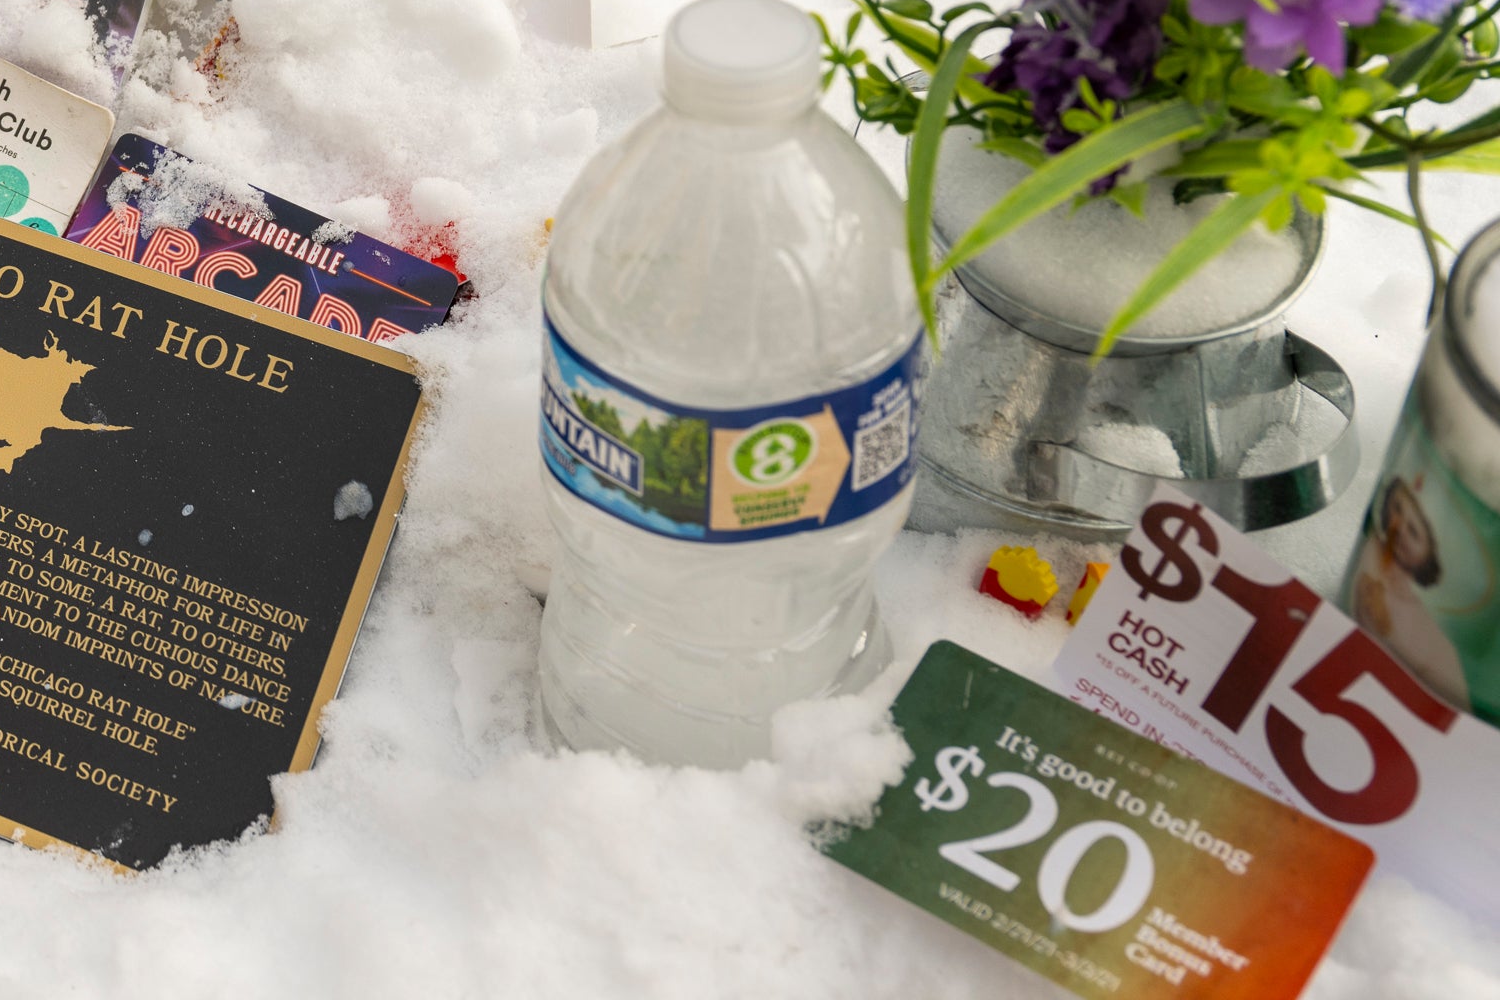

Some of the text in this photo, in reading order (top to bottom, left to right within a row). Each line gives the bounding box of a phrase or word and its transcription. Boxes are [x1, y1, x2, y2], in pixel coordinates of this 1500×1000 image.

[38, 279, 144, 339] RAT
[155, 319, 294, 394] HOLE
[14, 513, 69, 547] SPOT,
[71, 535, 86, 553] A
[90, 540, 178, 585] LASTING
[181, 573, 308, 633] IMPRESSION
[40, 548, 54, 566] A
[58, 553, 170, 608] METAPHOR
[172, 595, 214, 624] FOR
[217, 612, 265, 642] LIFE
[267, 630, 292, 652] IN
[7, 557, 34, 581] TO
[37, 570, 95, 607] SOME,
[99, 595, 115, 613] A
[119, 600, 164, 632] RAT,
[170, 618, 198, 642] TO
[201, 631, 287, 678] OTHERS,
[1118, 610, 1185, 660] HOT
[53, 599, 81, 623] TO
[86, 611, 128, 641] THE
[130, 630, 219, 675] CURIOUS
[221, 663, 292, 703] DANCE
[64, 629, 165, 680] IMPRINTS
[168, 669, 197, 691] OF
[1107, 632, 1190, 695] CASH
[1120, 501, 1462, 827] $15
[86, 688, 131, 717] RAT
[1075, 676, 1141, 727] SPEND
[1114, 665, 1141, 686] OFF
[1151, 691, 1201, 731] FUTURE
[101, 719, 158, 755] HOLE.
[75, 761, 178, 813] SOCIETY
[995, 725, 1040, 763] It's
[1038, 753, 1117, 801] good
[1115, 788, 1148, 818] to
[1149, 802, 1255, 877] belong
[914, 745, 1155, 934] $20
[939, 881, 994, 923] VALID
[1124, 942, 1189, 987] Card
[1136, 923, 1213, 978] Bonus
[1147, 907, 1250, 973] Member
